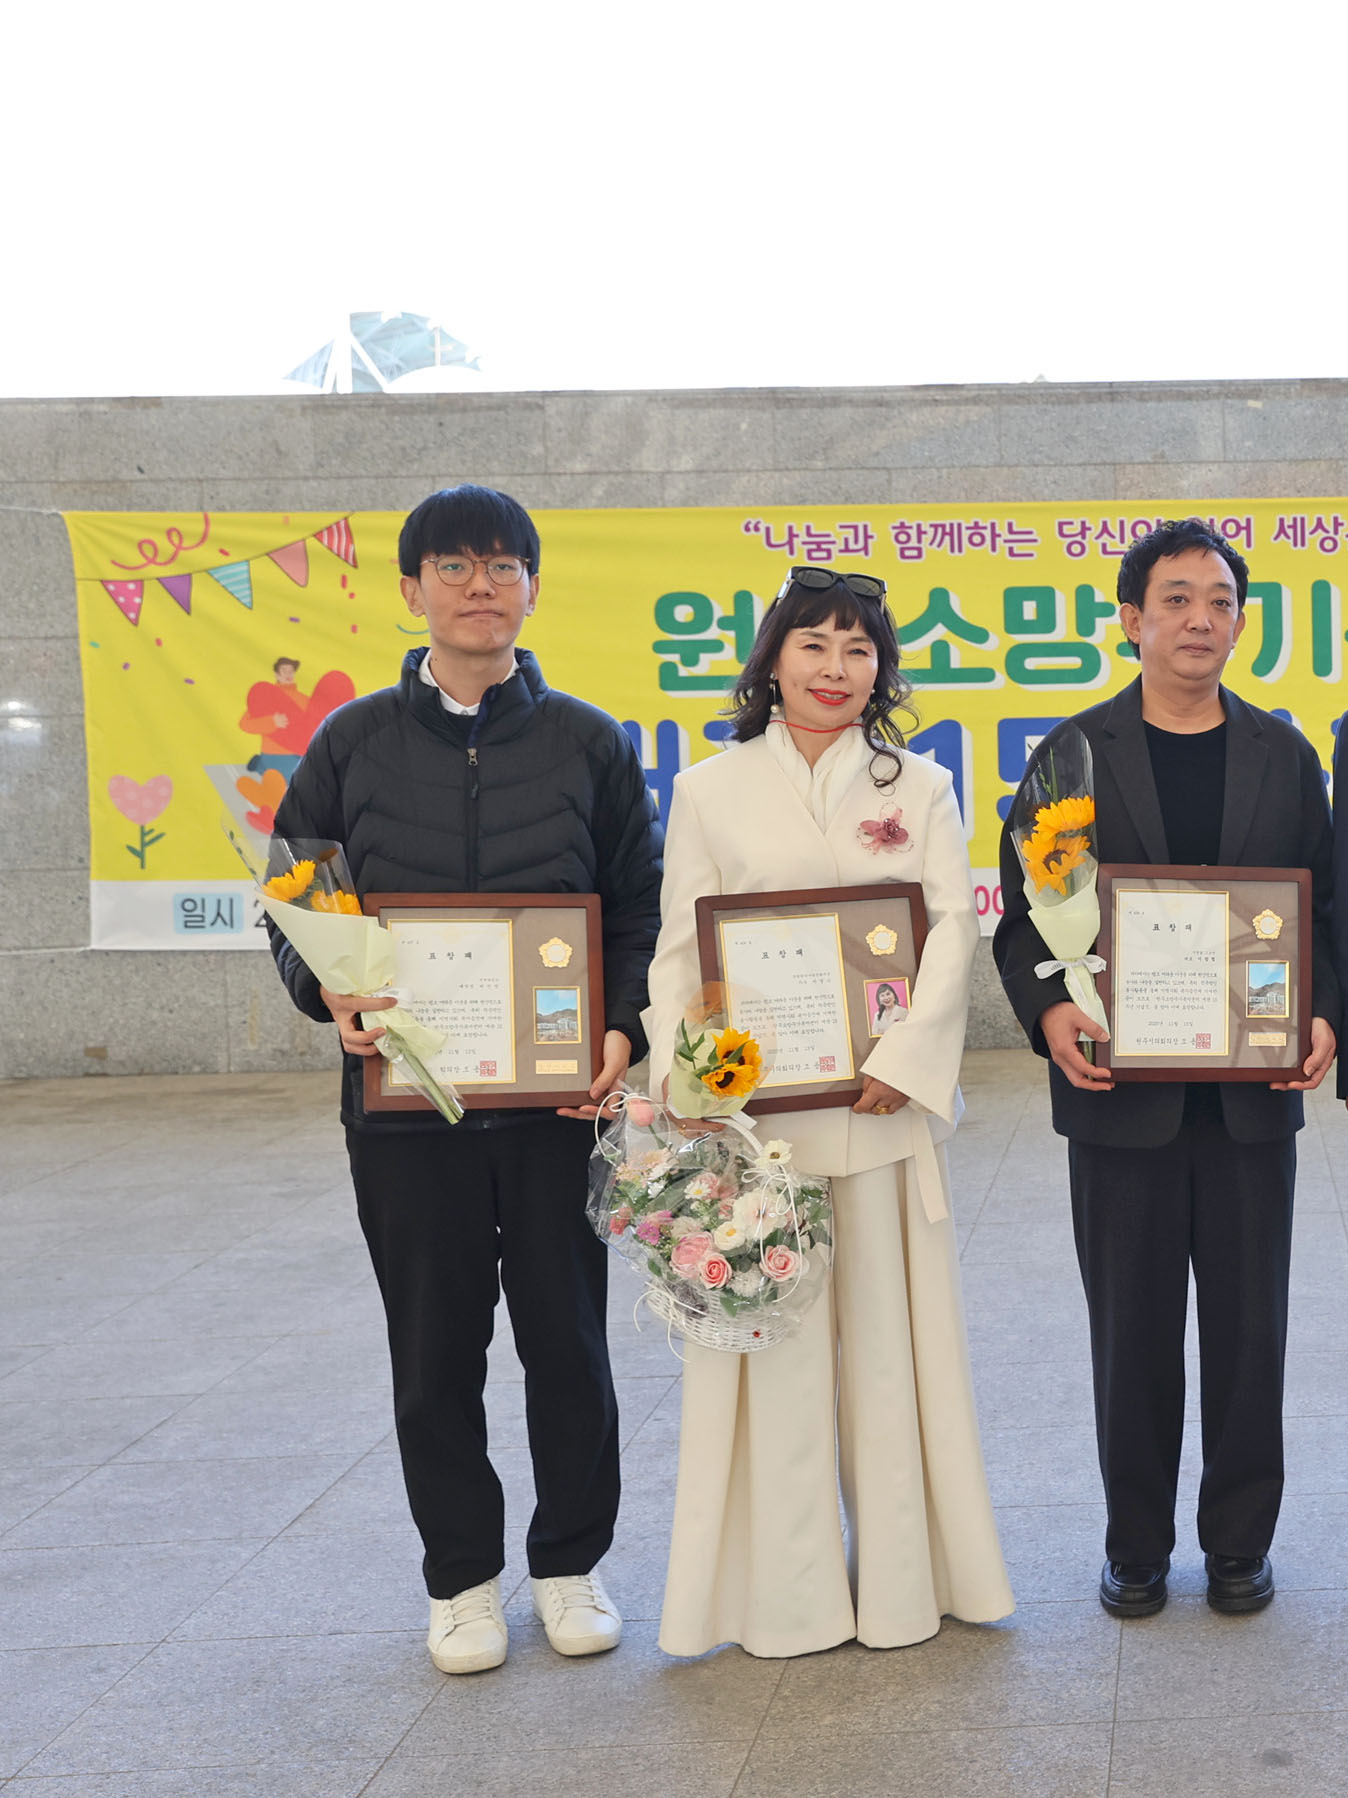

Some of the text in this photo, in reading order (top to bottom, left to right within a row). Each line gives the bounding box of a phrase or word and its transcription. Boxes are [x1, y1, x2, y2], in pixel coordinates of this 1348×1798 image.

[743, 520, 874, 561] “나눔과
[891, 521, 1039, 560] 함께하는
[181, 898, 234, 929] 일시
